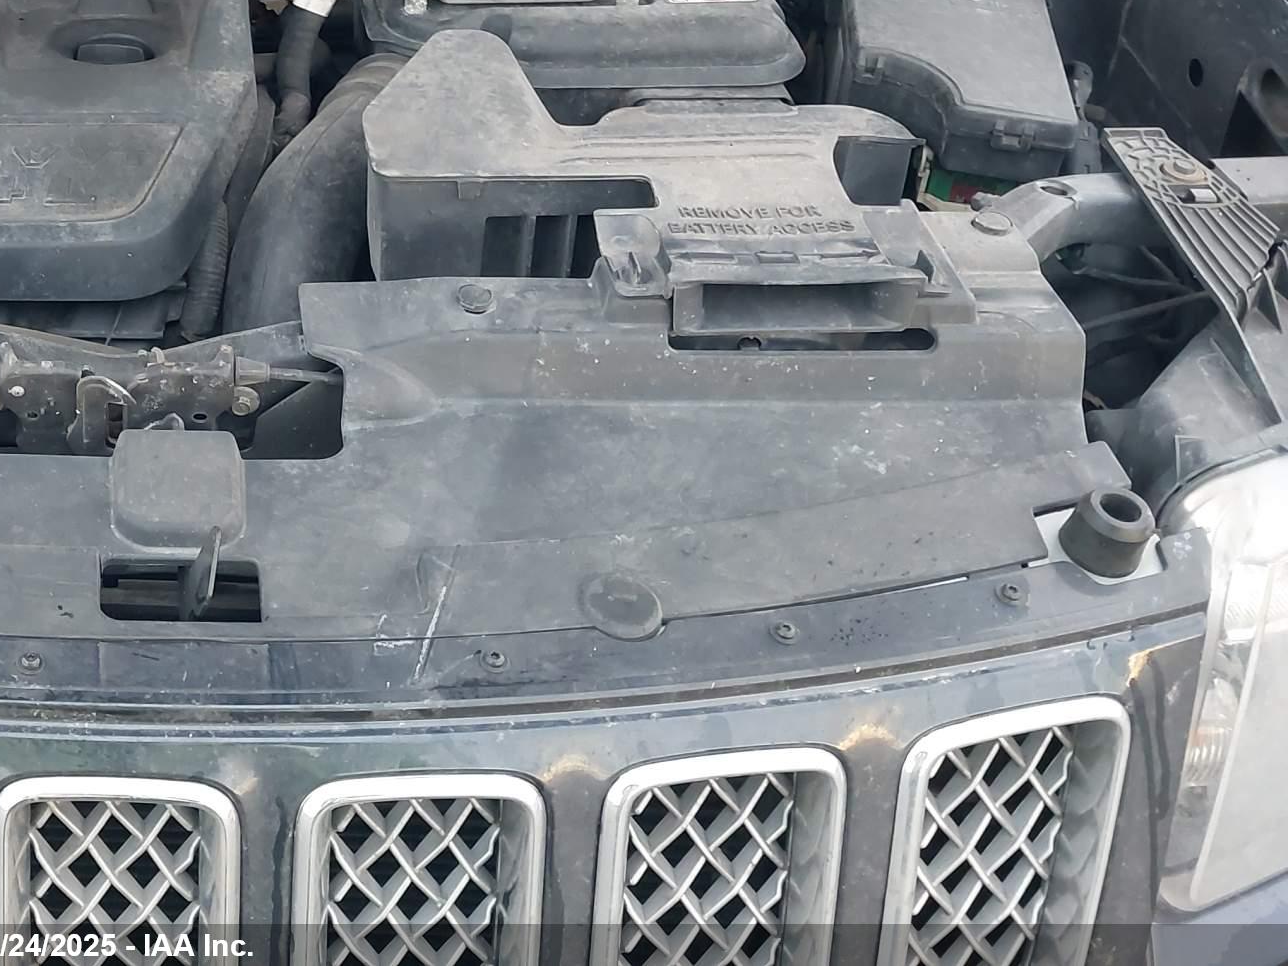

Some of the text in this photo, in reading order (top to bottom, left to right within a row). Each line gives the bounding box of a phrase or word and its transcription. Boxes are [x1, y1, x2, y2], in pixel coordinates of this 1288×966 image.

[678, 205, 822, 220] REMOVE FOR
[667, 220, 856, 235] BATTERY ACCESS
